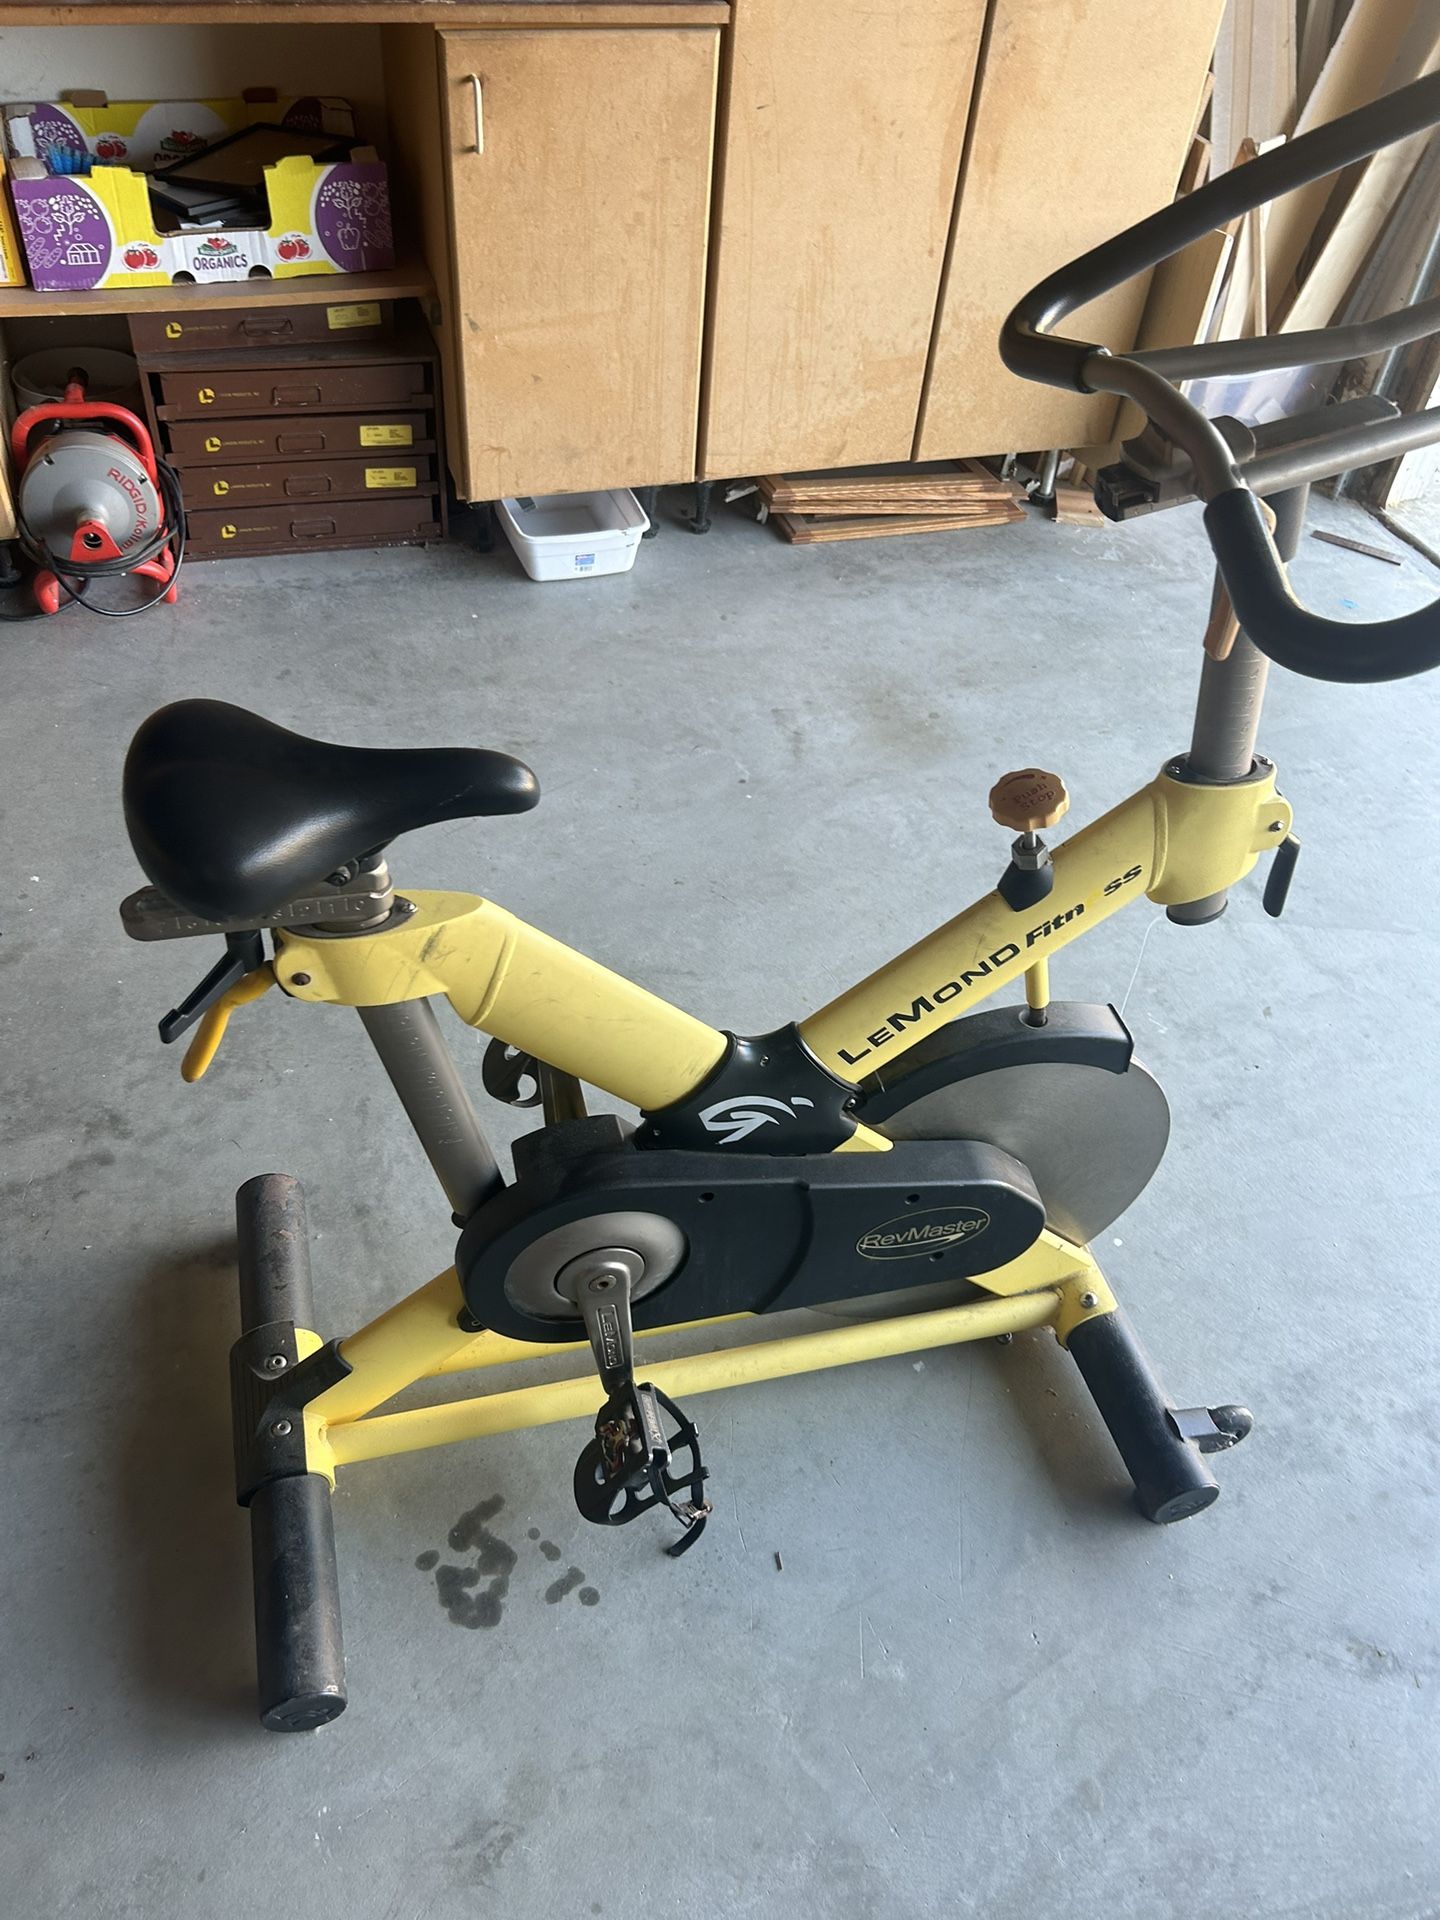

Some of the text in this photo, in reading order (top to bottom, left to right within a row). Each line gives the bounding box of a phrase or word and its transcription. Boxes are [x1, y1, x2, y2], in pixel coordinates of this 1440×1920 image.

[193, 254, 248, 270] ORGANICS
[1026, 864, 1142, 948] Fitnss
[861, 1218, 987, 1248] RevMaster
